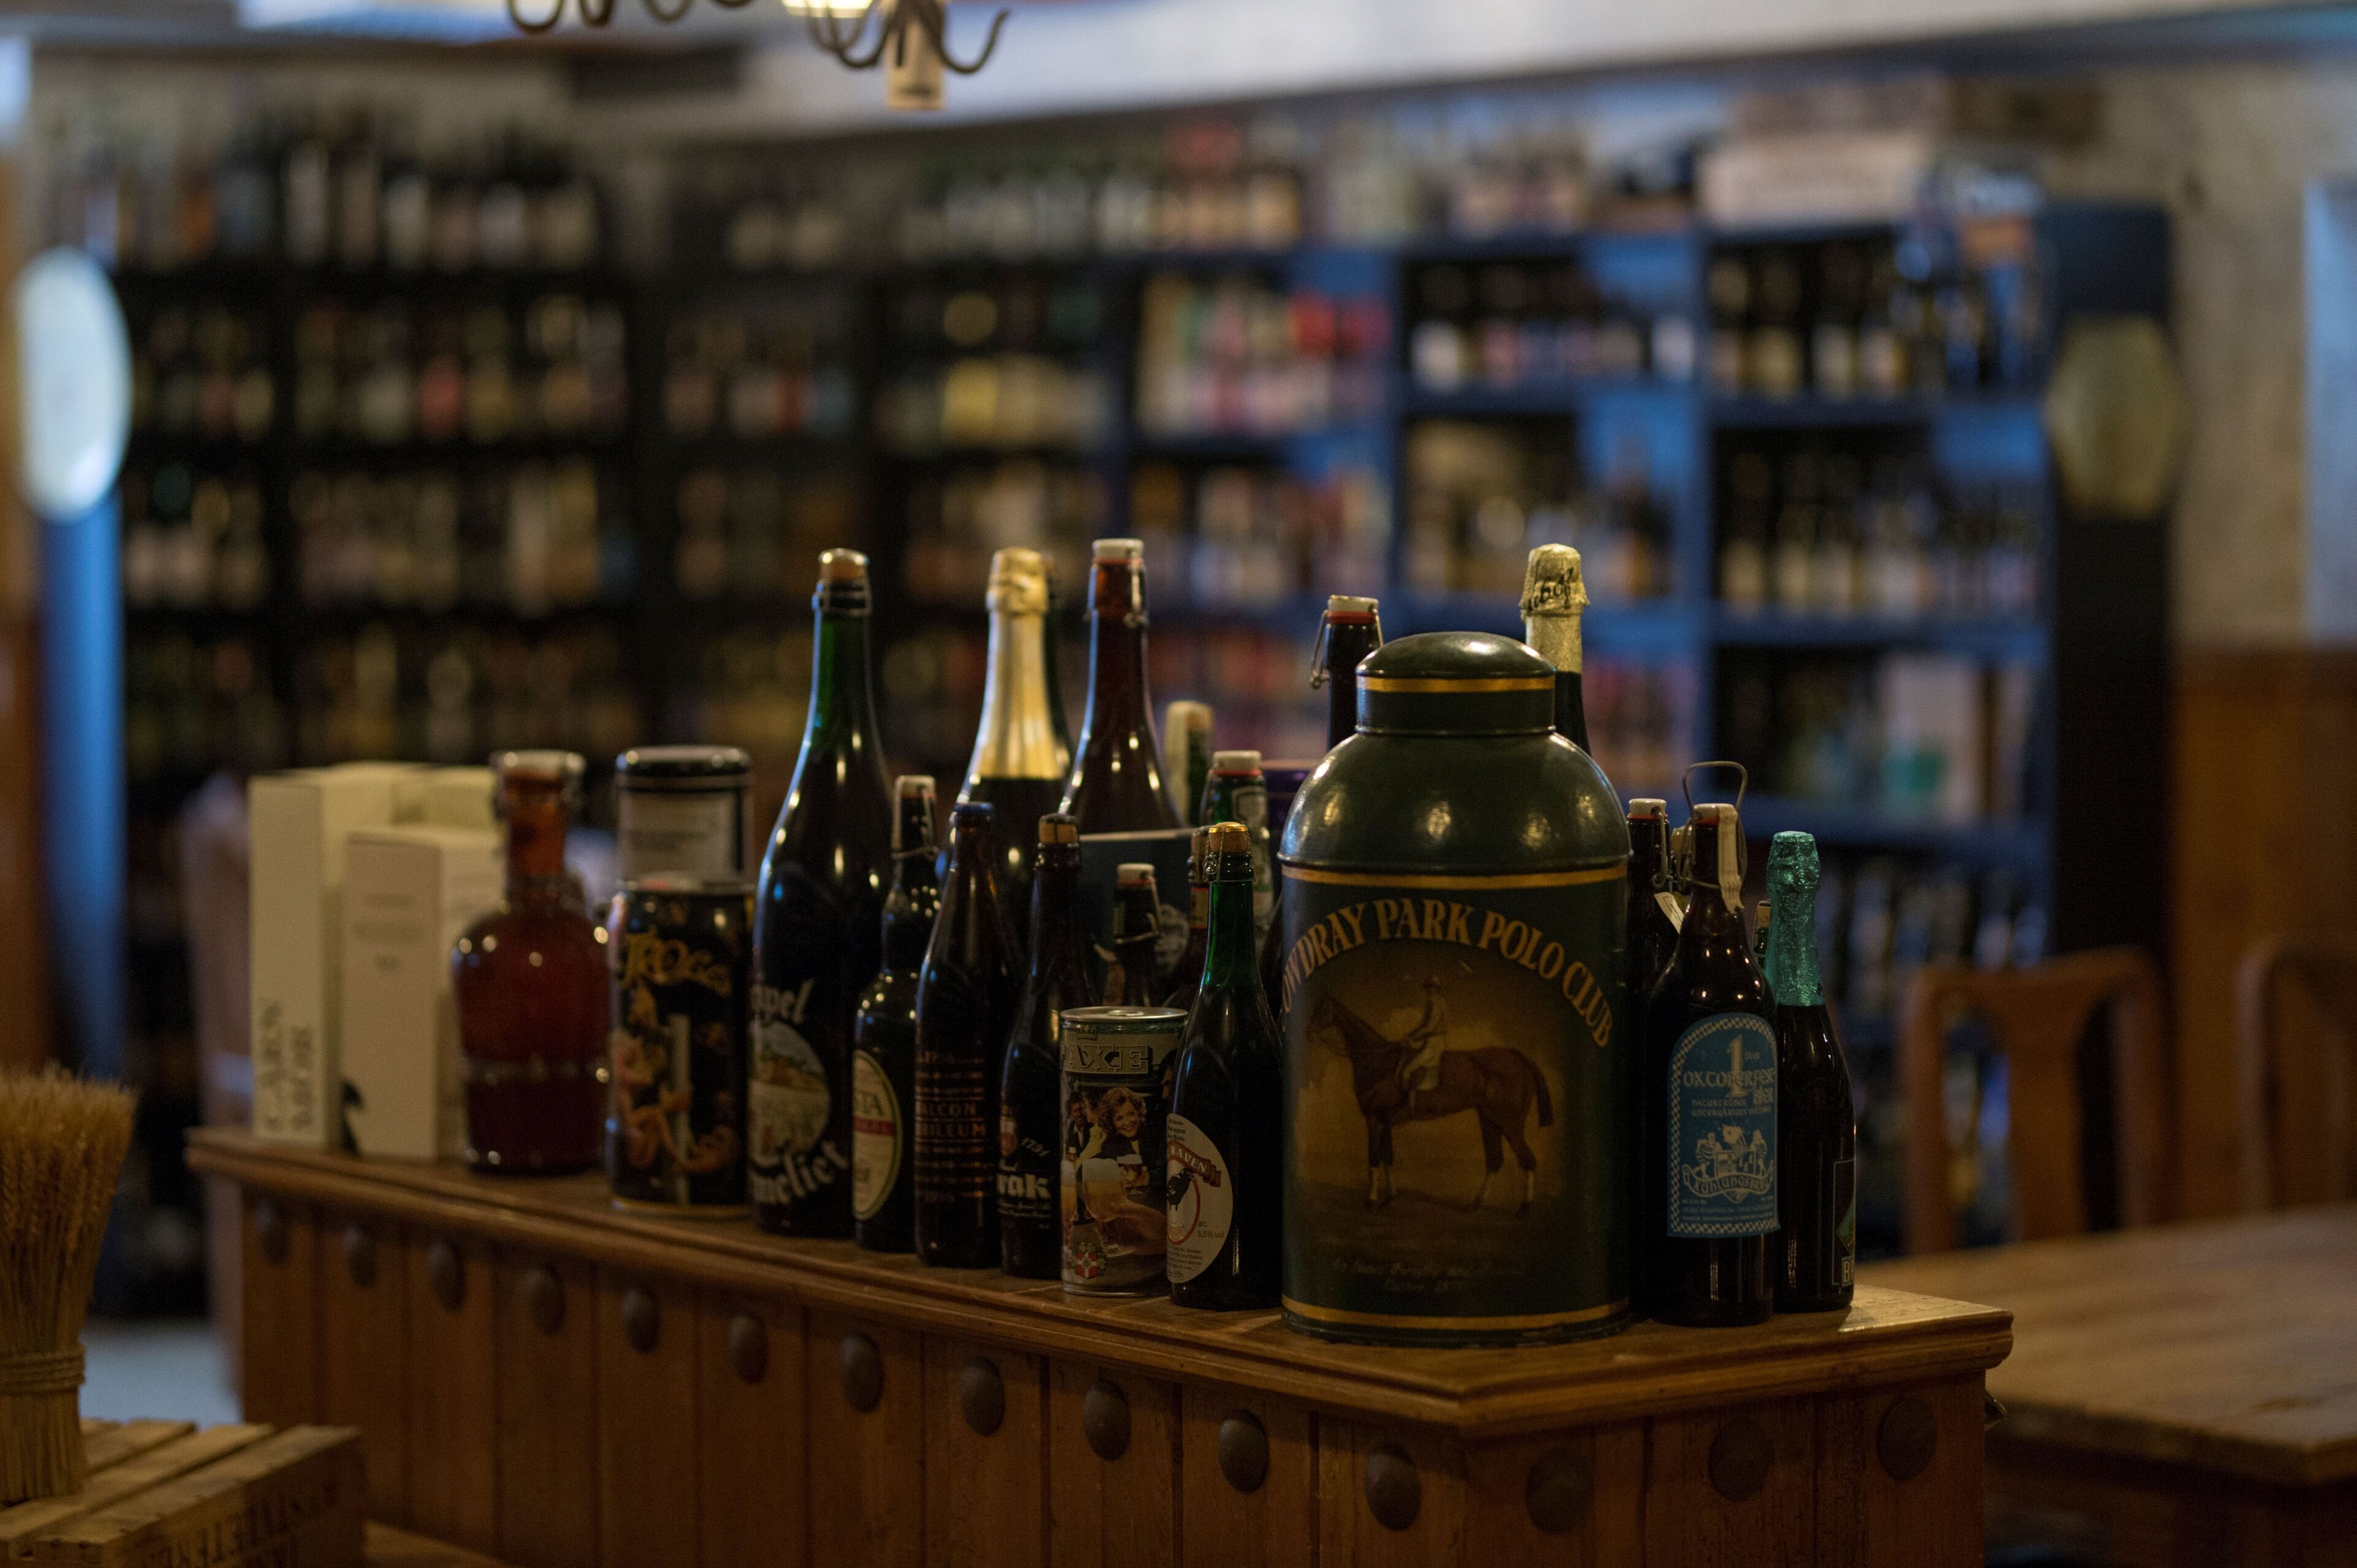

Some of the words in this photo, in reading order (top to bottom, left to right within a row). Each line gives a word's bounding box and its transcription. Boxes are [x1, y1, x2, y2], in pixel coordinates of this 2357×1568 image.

[1282, 903, 1366, 1032] OWDRAY
[1374, 898, 1474, 946] PARK
[1478, 911, 1565, 980] POLO
[1562, 961, 1614, 1049] CLUB
[1062, 1043, 1151, 1075] AXE
[1170, 1145, 1207, 1173] RAVEN
